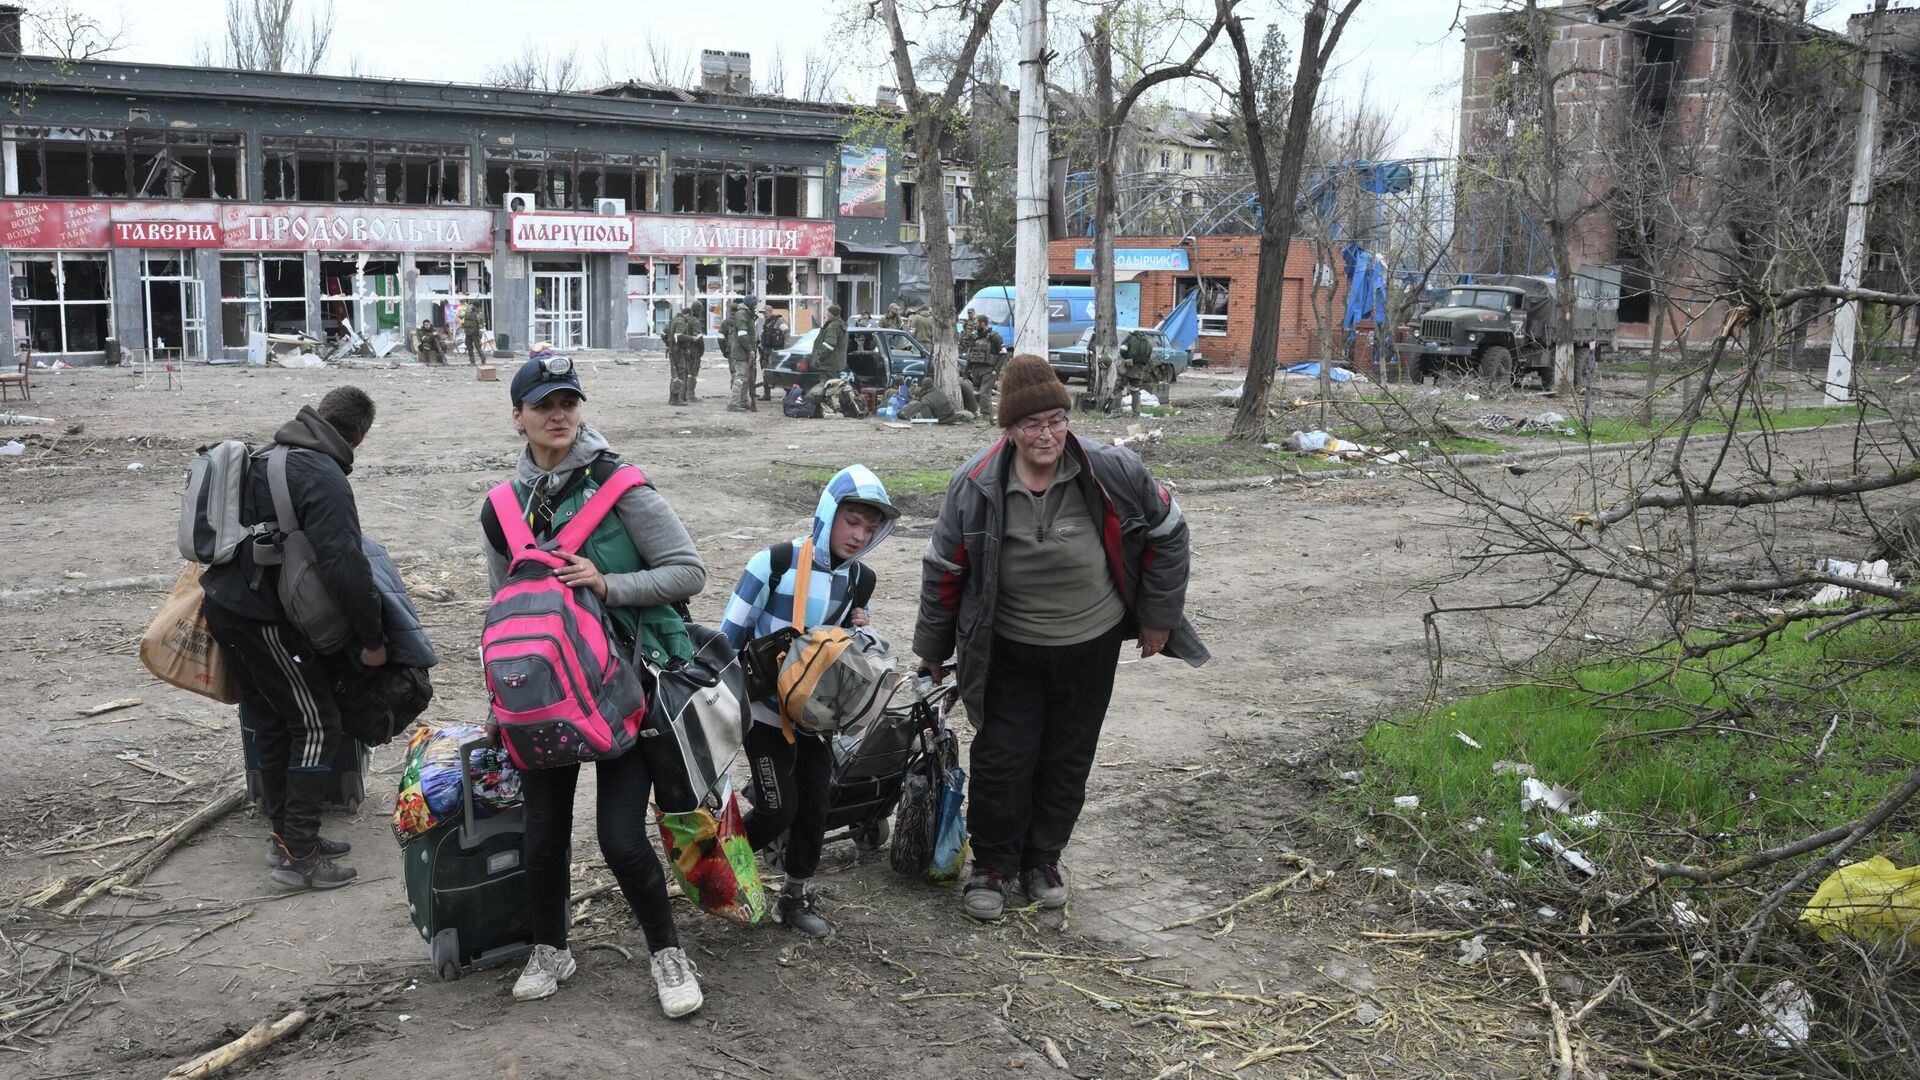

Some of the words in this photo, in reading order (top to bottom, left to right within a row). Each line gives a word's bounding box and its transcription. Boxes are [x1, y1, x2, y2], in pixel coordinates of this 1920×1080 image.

[14, 203, 49, 217] ВОДКА
[68, 203, 101, 218] ТАБАК
[10, 215, 45, 229] ВОДКА
[63, 215, 97, 229] ТАБАК
[6, 226, 41, 241] ВОДКА
[59, 226, 93, 241] ТАБАК
[116, 223, 217, 241] ТАВЕРНА
[247, 216, 465, 246] ПРОДОВОЛЬЧА
[518, 223, 630, 246] МАРІУПОЛЬ
[662, 225, 799, 255] КРАМНИЦЯ
[1086, 255, 1171, 266] МОДЫРЧИК
[1049, 304, 1065, 317] Z
[775, 352, 792, 372] Z
[903, 359, 925, 375] Z
[759, 756, 775, 788] HABITS
[766, 788, 778, 809] BAD
